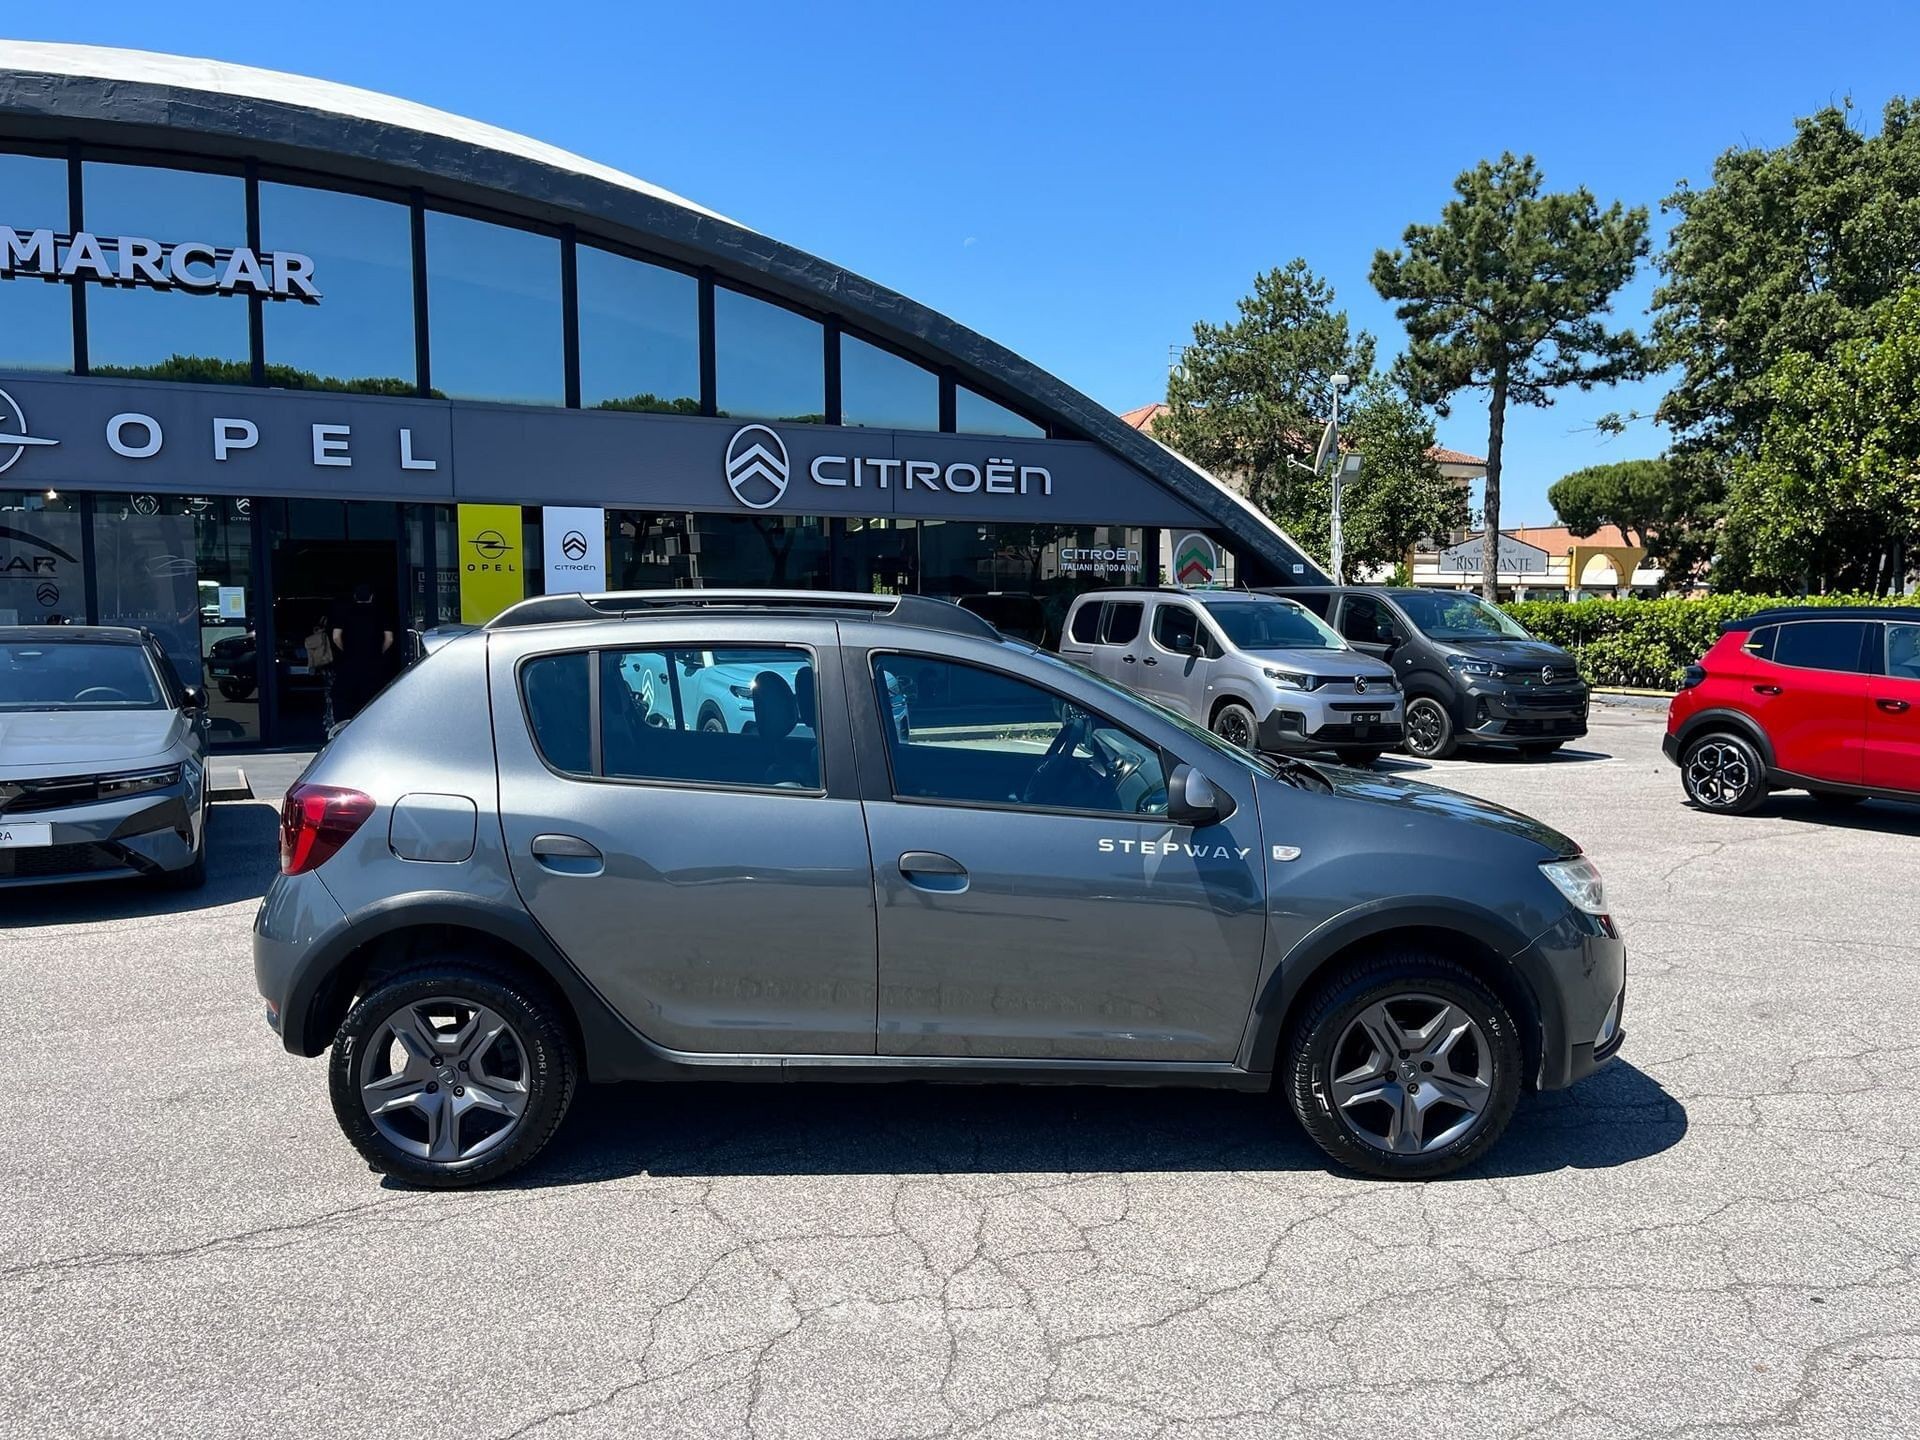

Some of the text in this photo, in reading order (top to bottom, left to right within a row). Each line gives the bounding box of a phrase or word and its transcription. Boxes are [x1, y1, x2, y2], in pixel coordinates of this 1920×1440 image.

[0, 226, 323, 298] MARCAR
[106, 413, 436, 470] OPEL
[467, 563, 515, 571] OPEL
[1060, 563, 1092, 571] ITALIANI
[1106, 564, 1119, 572] 100
[1120, 564, 1140, 572] ANNI
[1098, 838, 1251, 860] STEPWAY
